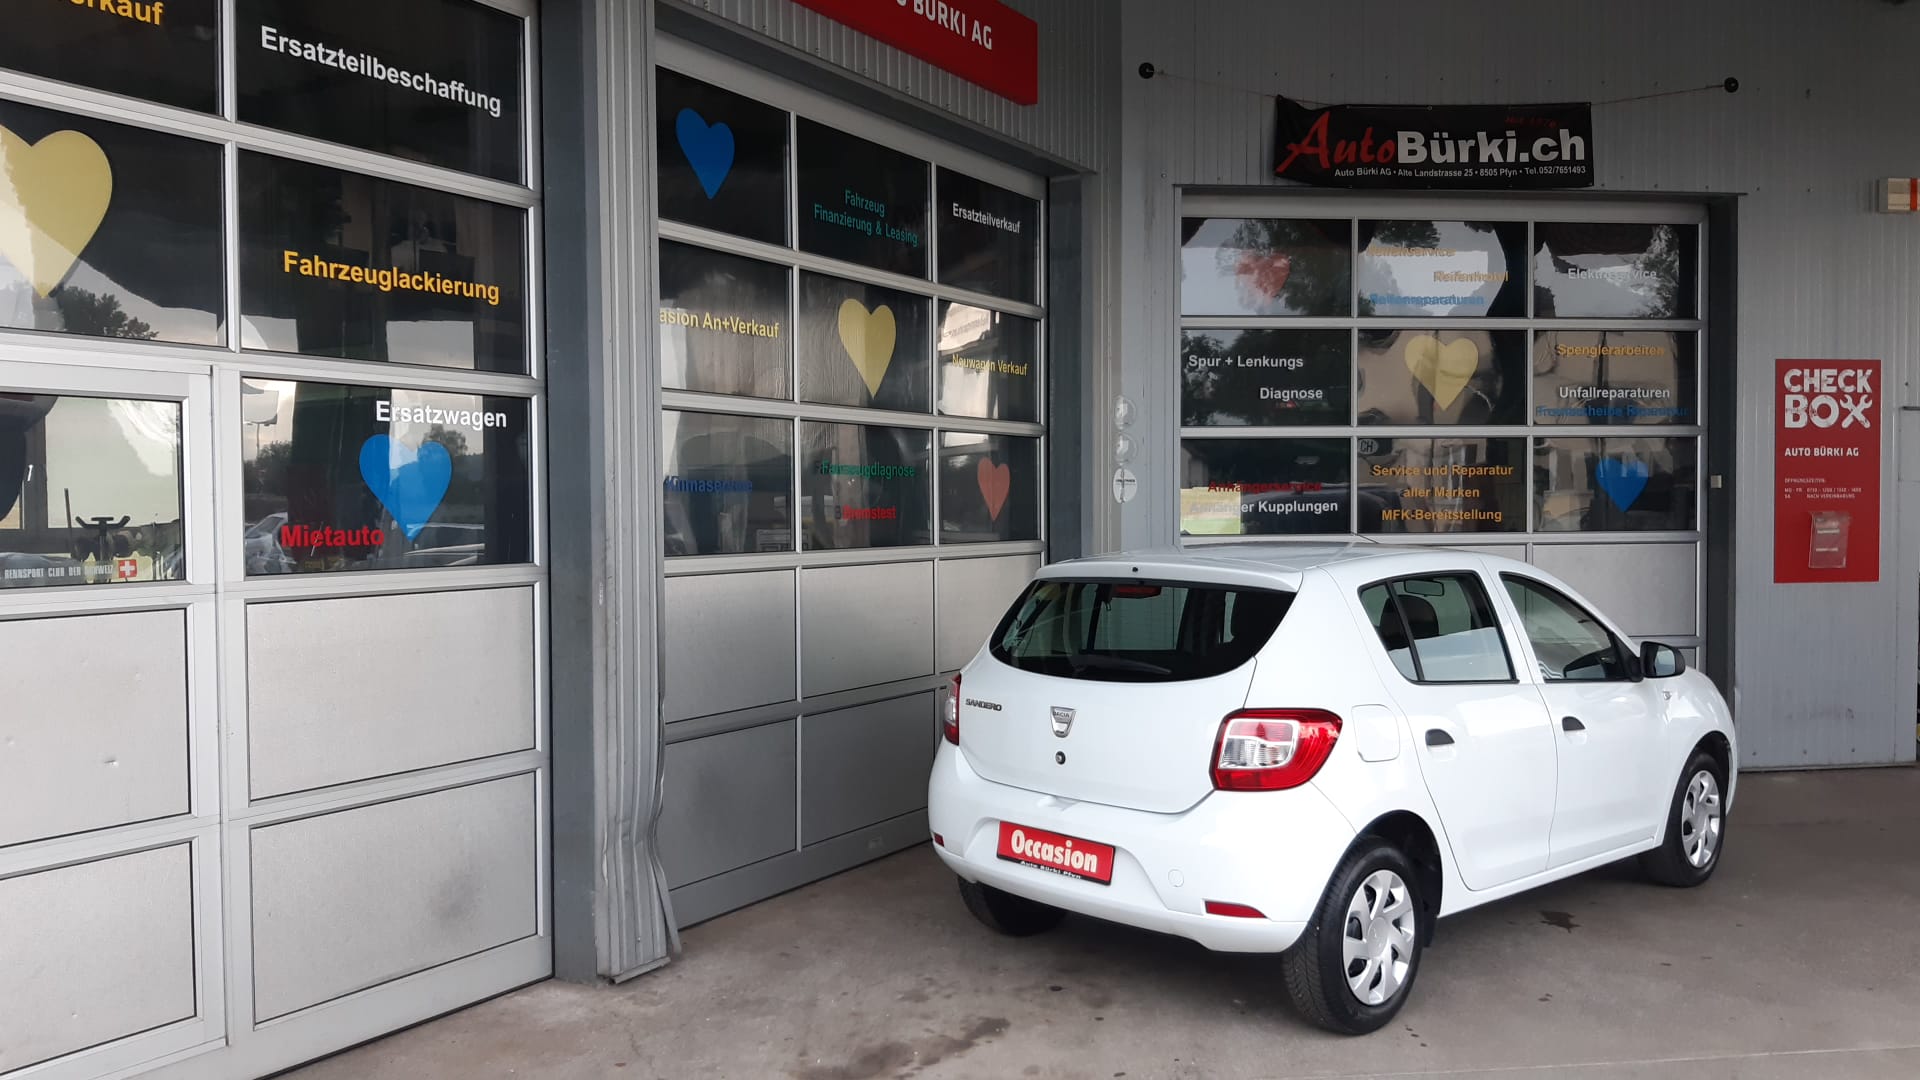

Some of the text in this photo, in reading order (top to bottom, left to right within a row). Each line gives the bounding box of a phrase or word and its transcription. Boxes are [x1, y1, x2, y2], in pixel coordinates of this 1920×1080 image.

[971, 20, 993, 50] AG
[261, 25, 502, 118] Ersatzteilbeschaffung
[1334, 168, 1355, 177] Auto
[1356, 167, 1379, 176] Bürki
[1379, 168, 1392, 176] AG
[1398, 168, 1413, 177] Alte
[1414, 168, 1463, 177] Landstrasse
[1463, 168, 1474, 177] 25
[1479, 168, 1498, 177] 8505
[1499, 168, 1518, 178] Pfyn
[845, 189, 886, 218] Fahrzeug
[814, 203, 919, 248] Finanzierung & Leasing
[952, 202, 1021, 234] Ersatzteilverkauf
[283, 250, 500, 306] Fahrzeuglackierung
[702, 311, 780, 338] An+Verkauf
[1557, 343, 1665, 358] Spenglerarbeiten
[997, 359, 1028, 377] Verkauf
[1188, 355, 1304, 370] Spur + Lenkungs
[1783, 368, 1873, 393] CHECK
[1259, 387, 1323, 402] Diagnose
[1559, 386, 1671, 401] Unfallreparaturen
[376, 400, 508, 431] Ersatzwagen
[1784, 445, 1860, 457] AUTO BÜRKI AG
[1373, 464, 1514, 478] Service und Reparatur
[1207, 480, 1323, 494] Anhängerservice
[1403, 487, 1480, 497] aller Marken
[1258, 501, 1338, 515] Kupplungen
[1381, 508, 1503, 522] MFK-Bereitstellung
[281, 523, 386, 548] Mietauto
[48, 567, 65, 578] CLUB
[68, 566, 82, 577] DER
[965, 698, 1003, 712] SANDERO
[1010, 829, 1098, 874] Occasion
